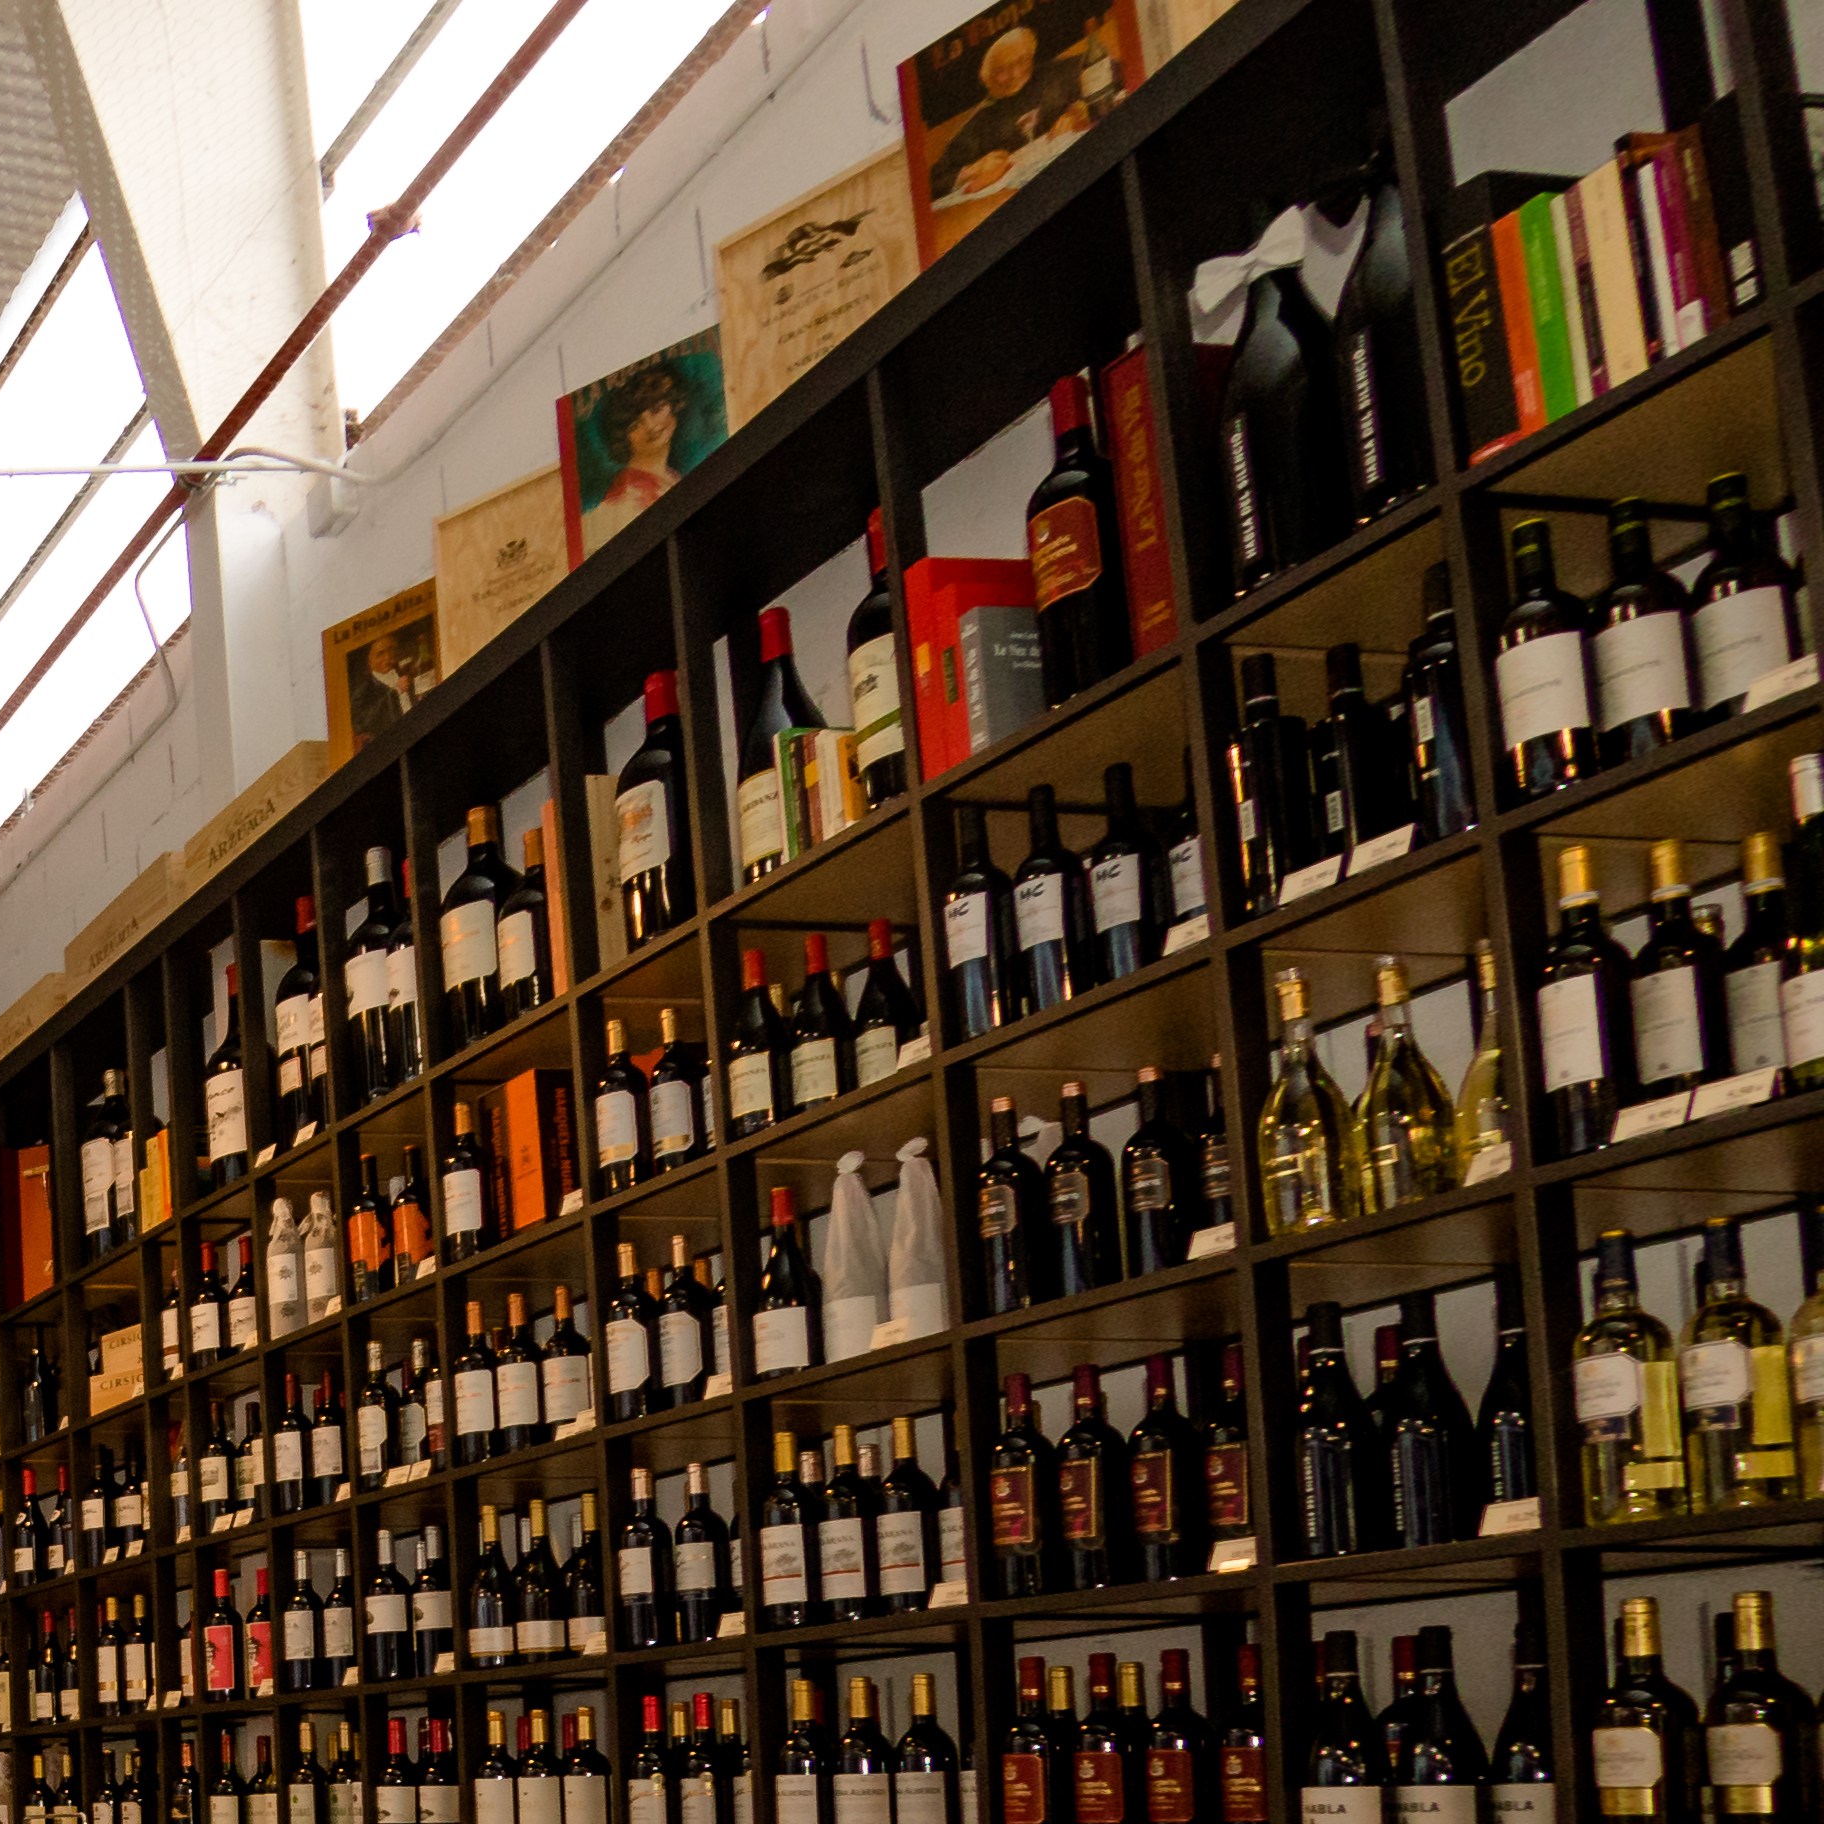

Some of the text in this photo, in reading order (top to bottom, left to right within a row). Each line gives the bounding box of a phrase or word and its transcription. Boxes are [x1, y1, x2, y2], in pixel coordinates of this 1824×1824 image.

[1445, 243, 1492, 389] El Vino
[1359, 408, 1375, 440] DEL
[1362, 437, 1381, 485] HABLA
[1238, 488, 1253, 517] DEL
[1241, 515, 1258, 560] HABLA
